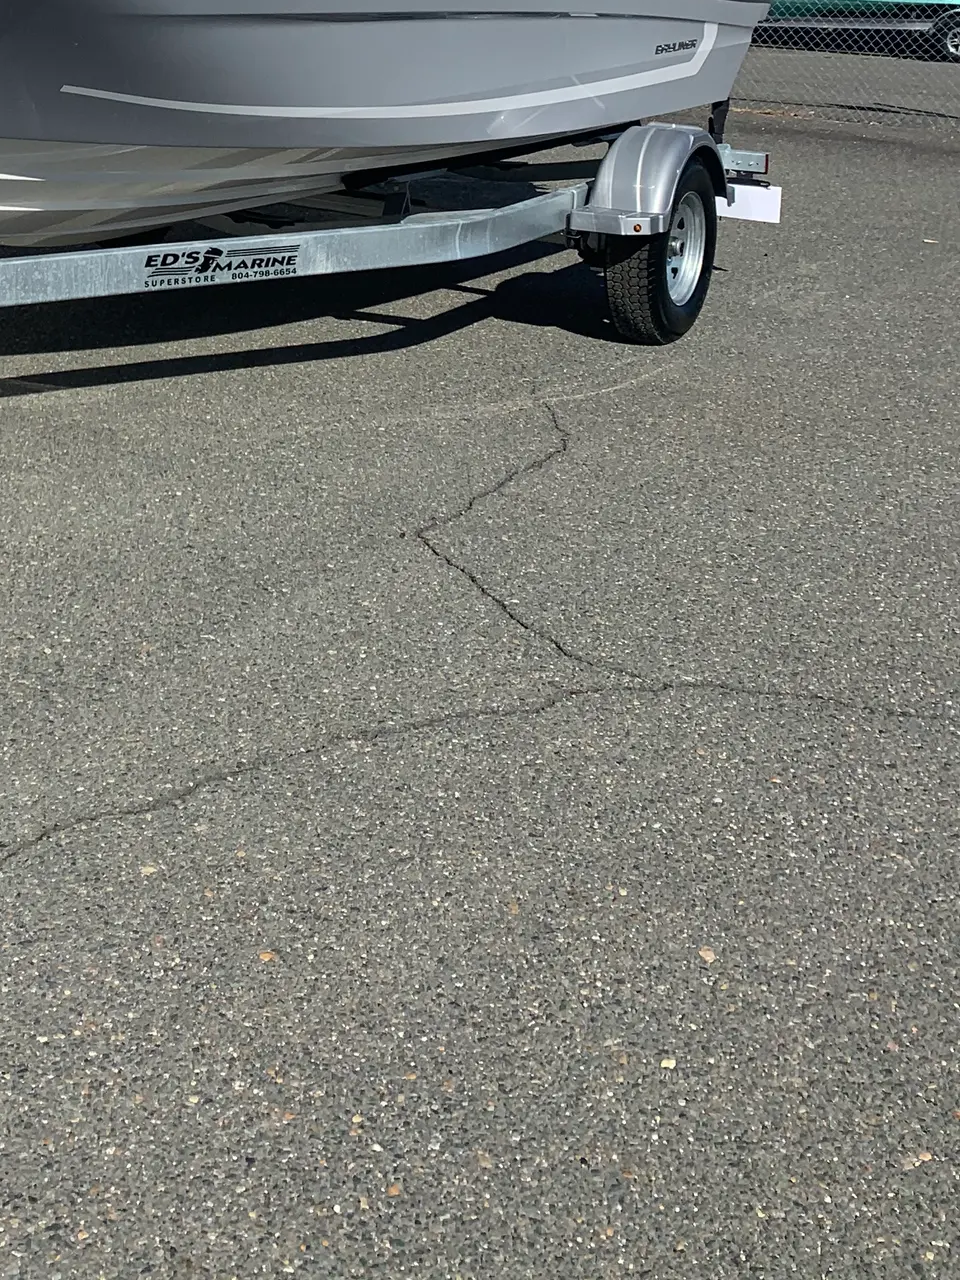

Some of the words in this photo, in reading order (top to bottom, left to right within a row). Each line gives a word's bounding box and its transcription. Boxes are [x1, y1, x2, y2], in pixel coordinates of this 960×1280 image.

[144, 250, 201, 268] ED'S
[212, 255, 298, 273] MARINE
[144, 274, 216, 288] SUPERSTORE
[231, 267, 298, 281] 804-798-6654
